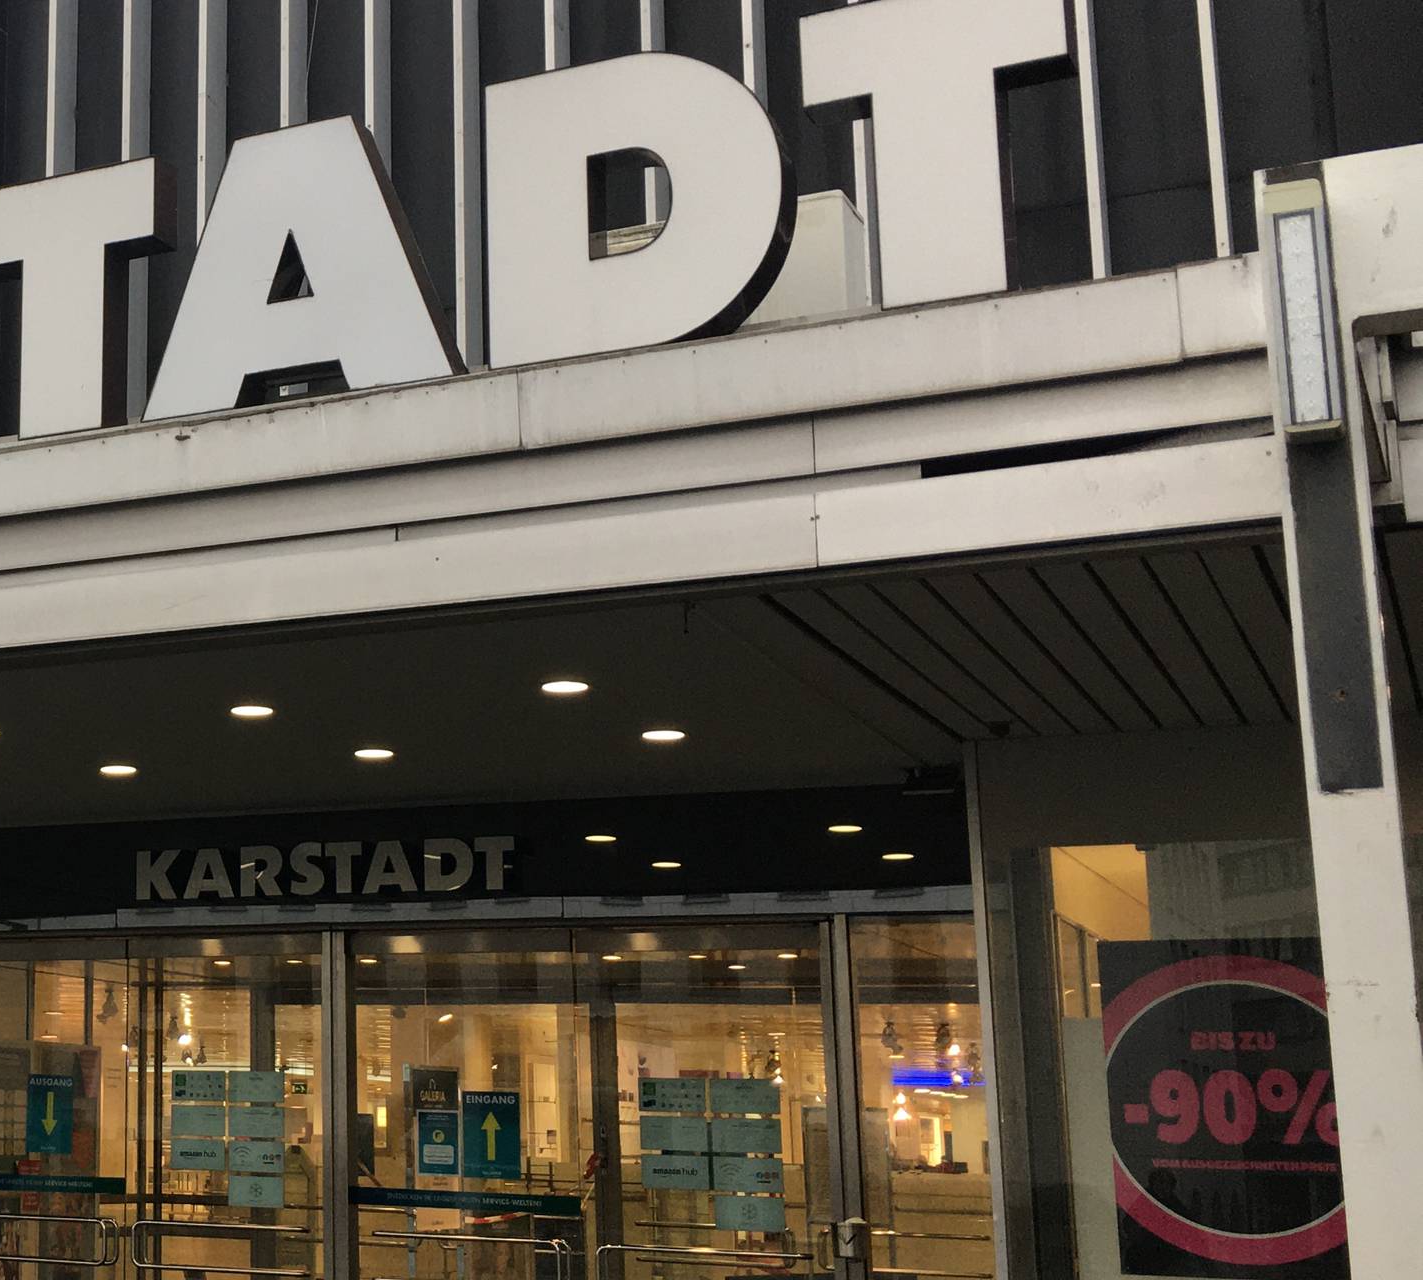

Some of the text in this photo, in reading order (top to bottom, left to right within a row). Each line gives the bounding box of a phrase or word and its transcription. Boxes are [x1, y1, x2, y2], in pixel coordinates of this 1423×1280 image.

[135, 836, 515, 900] KARSTADT
[1190, 1030, 1276, 1051] BIS ZU
[29, 1077, 73, 1087] AUSGANG
[465, 1094, 516, 1105] EINGANG
[1123, 1067, 1340, 1147] -90%
[203, 1150, 217, 1158] hub
[681, 1166, 698, 1176] hub
